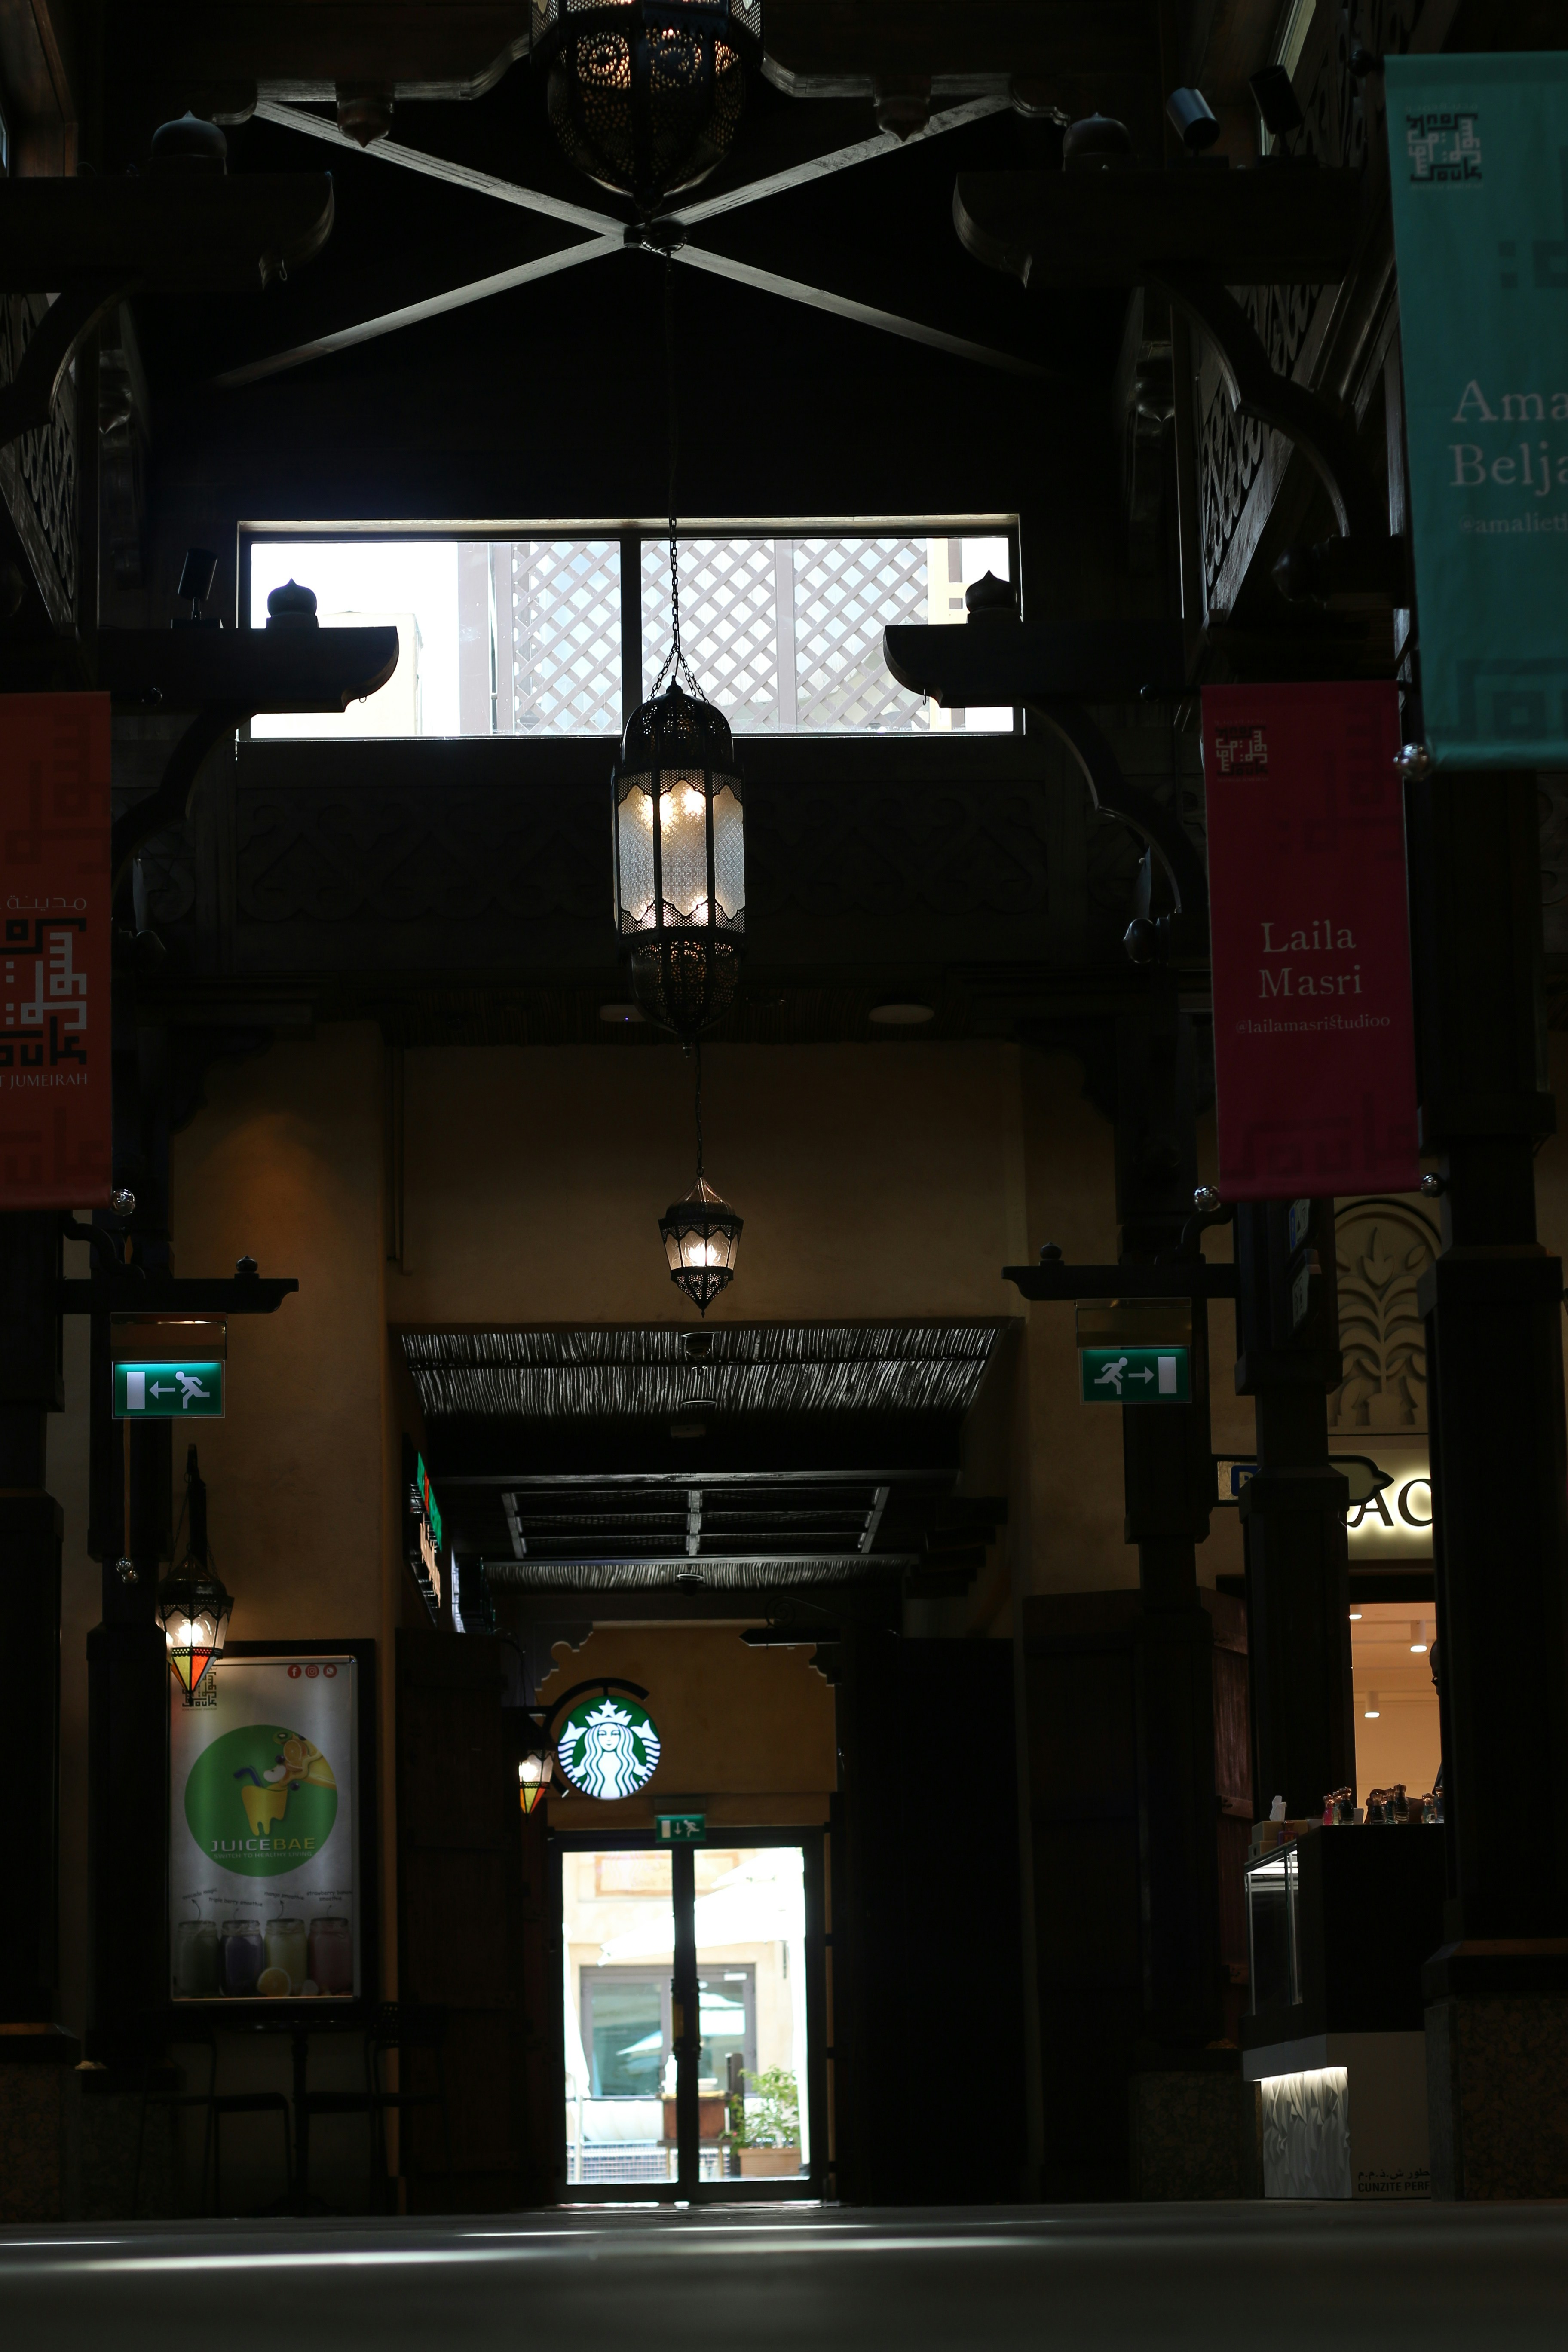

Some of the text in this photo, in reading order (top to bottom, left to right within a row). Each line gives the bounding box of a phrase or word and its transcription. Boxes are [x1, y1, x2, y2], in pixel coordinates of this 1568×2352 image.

[1410, 157, 1482, 181] Souk
[1217, 758, 1268, 775] Souk
[7, 894, 87, 912] مدينة
[1260, 919, 1357, 954] Laila
[1258, 965, 1363, 999] Masri
[1235, 1014, 1390, 1034] @lailamasristudioo
[10, 1073, 87, 1090] JUMEIRAH
[211, 1838, 315, 1852] JUICEBAE
[1358, 2181, 1430, 2192] CUNZITE PERF
